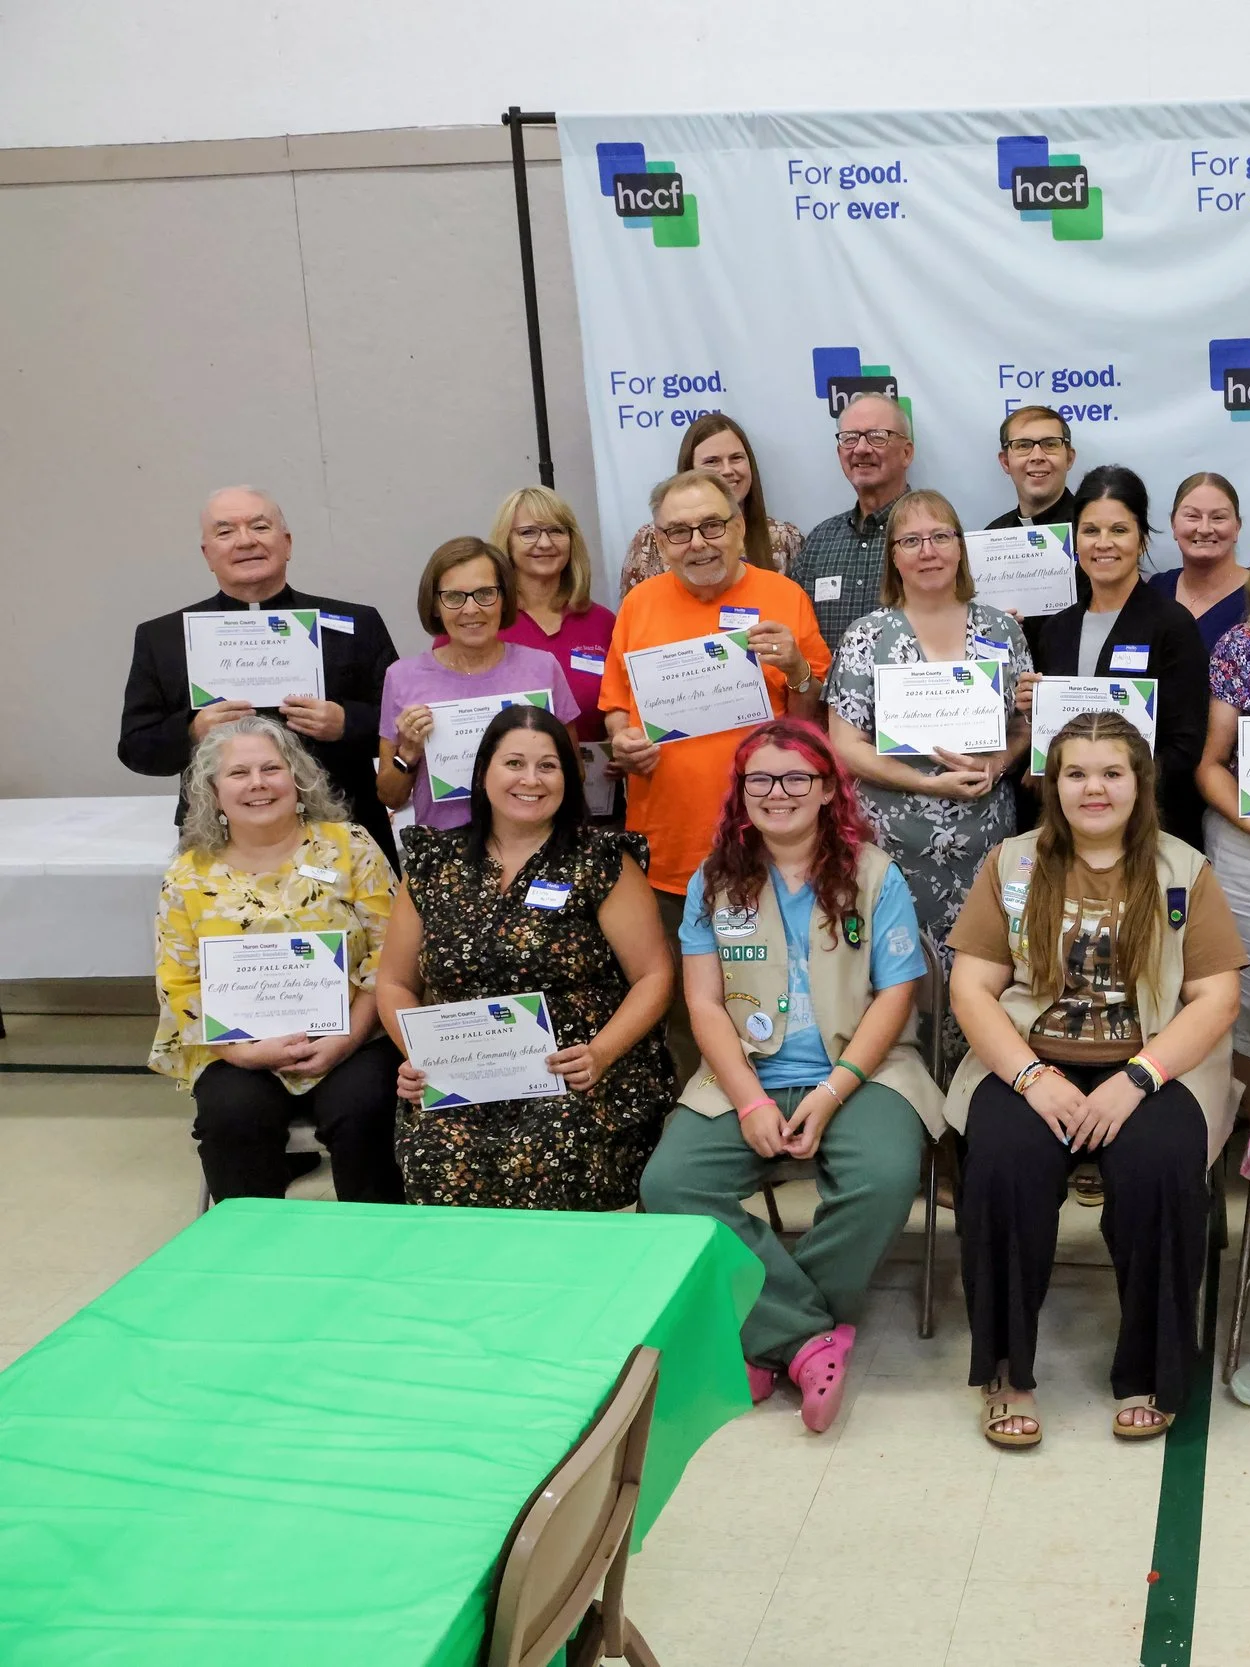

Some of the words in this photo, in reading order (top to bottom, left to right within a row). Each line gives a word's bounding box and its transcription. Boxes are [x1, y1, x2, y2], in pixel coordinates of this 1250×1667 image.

[1192, 151, 1239, 176] For
[789, 160, 832, 184] For
[840, 161, 907, 189] good.
[618, 182, 679, 209] hccf
[1016, 174, 1084, 202] hccf
[796, 196, 840, 220] For
[848, 202, 905, 219] ever.
[1198, 187, 1245, 212] For
[611, 372, 655, 395] For
[663, 371, 726, 398] good.
[999, 365, 1045, 388] For
[1052, 365, 1121, 393] good.
[619, 405, 664, 429] For
[1058, 404, 1118, 422] ever.
[1015, 570, 1037, 579] United
[235, 656, 254, 668] Casa
[271, 656, 290, 666] Casa
[661, 673, 680, 682] 2026
[681, 669, 700, 677] FALL
[701, 663, 727, 673] GRANT
[736, 679, 760, 691] County
[737, 711, 762, 720] $1,000
[901, 710, 932, 719] Lutheran
[935, 708, 959, 718] Church
[972, 705, 998, 715] School
[455, 728, 473, 736] 2026
[279, 991, 304, 1001] County
[310, 1021, 337, 1029] $1,000
[439, 1034, 460, 1042] 2026
[462, 1031, 484, 1039] FALL
[485, 1027, 514, 1036] GRANT
[450, 1053, 473, 1064] Beach
[475, 1049, 518, 1061] Community
[519, 1044, 548, 1056] Schools
